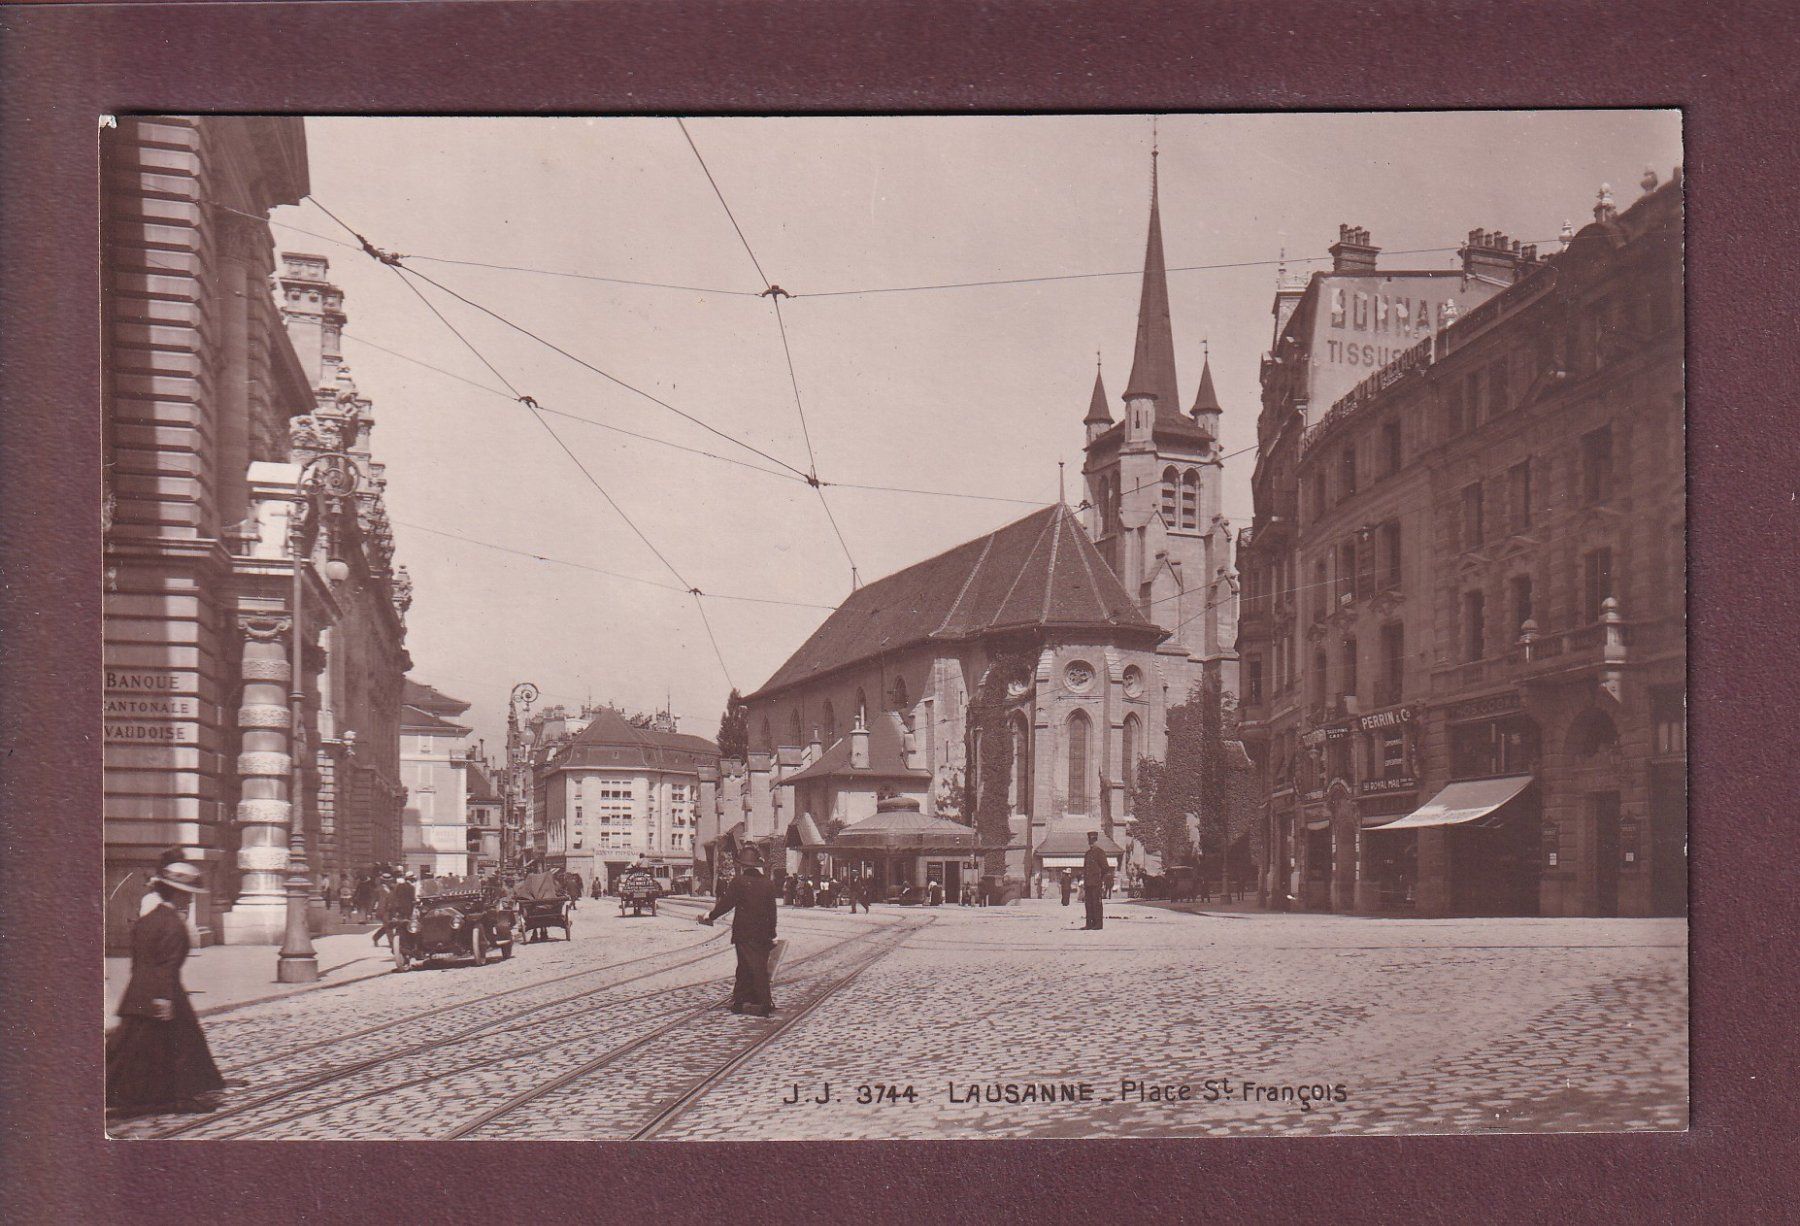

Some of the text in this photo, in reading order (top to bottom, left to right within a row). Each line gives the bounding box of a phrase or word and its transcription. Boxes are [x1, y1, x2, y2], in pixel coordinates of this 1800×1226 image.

[106, 672, 180, 690] BANQUE
[104, 701, 190, 714] ANTONALE
[1361, 711, 1396, 730] PERRIN
[104, 725, 186, 740] VAUDOISE
